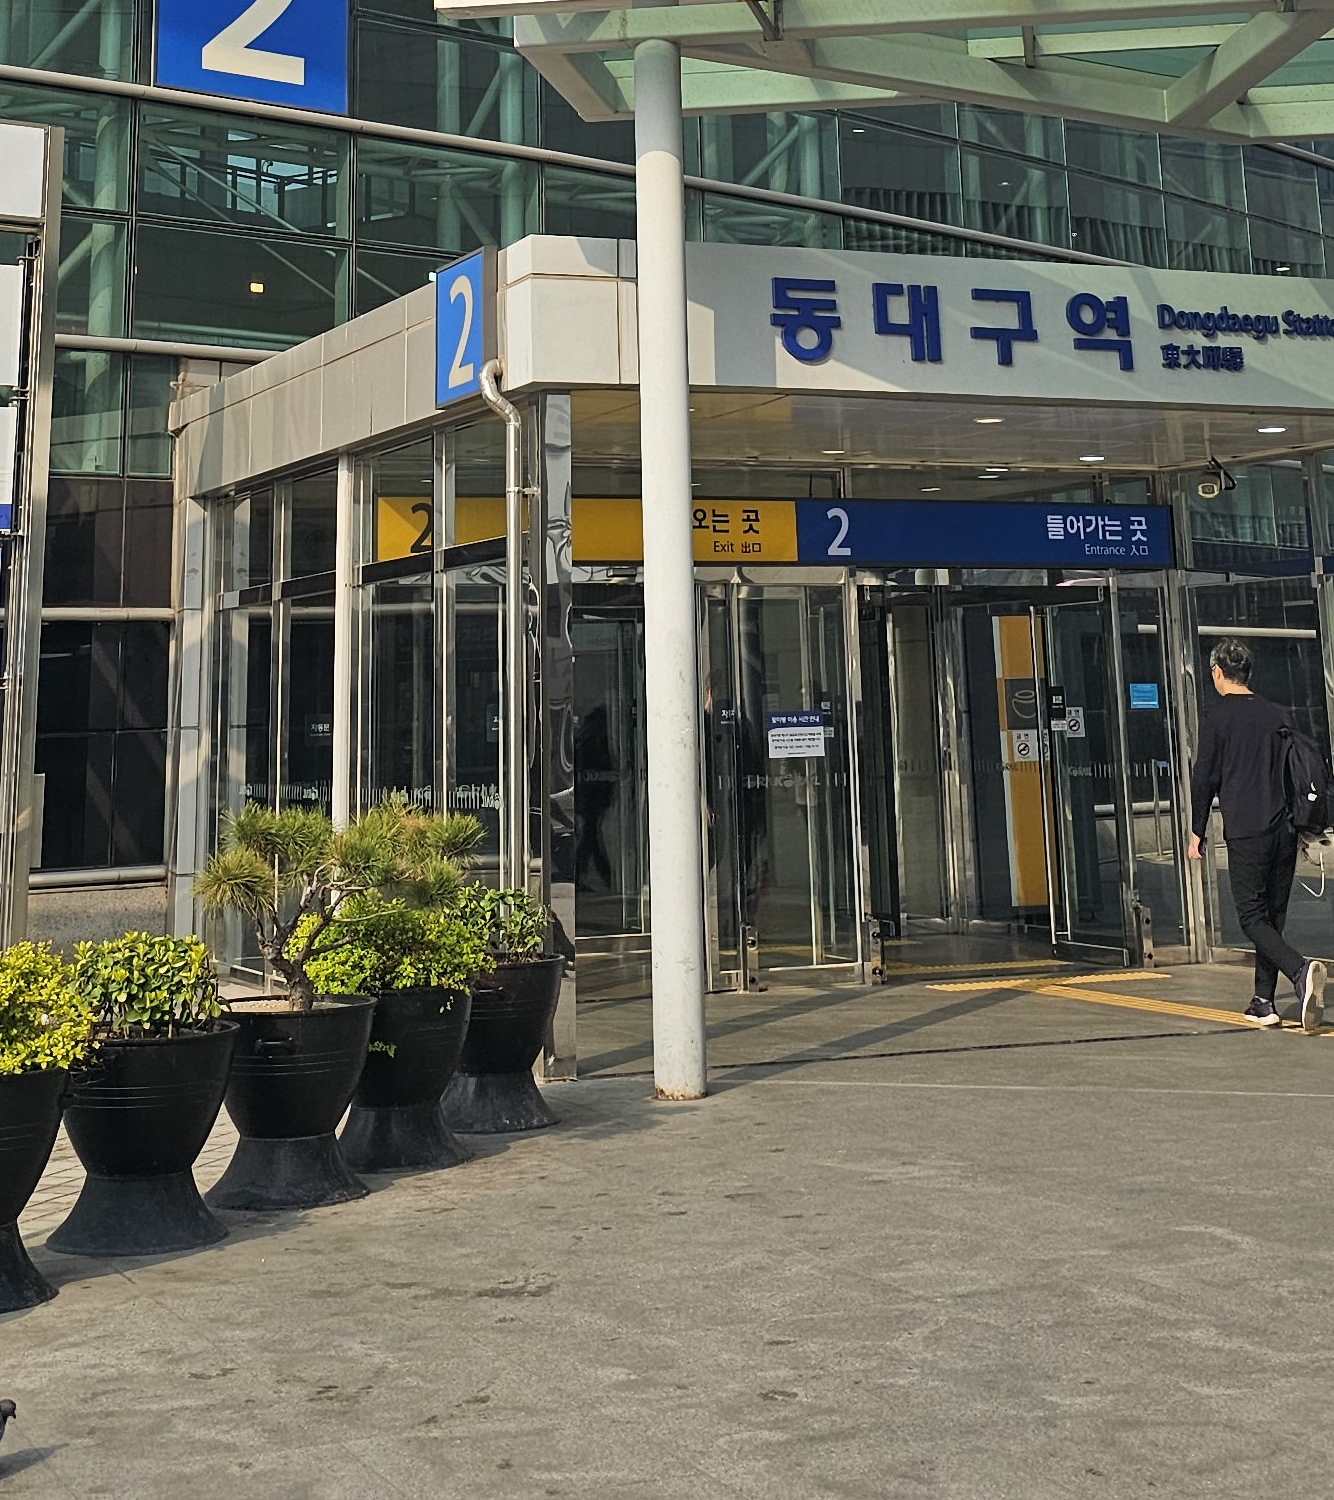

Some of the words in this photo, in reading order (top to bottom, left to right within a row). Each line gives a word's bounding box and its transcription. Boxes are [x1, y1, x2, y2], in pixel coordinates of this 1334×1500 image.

[447, 274, 475, 389] 2
[770, 275, 1134, 372] 동대구역
[1156, 304, 1280, 340] Dongdaegu
[409, 502, 434, 555] 2
[692, 508, 730, 533] 오는
[741, 509, 761, 535] 곳
[826, 507, 852, 556] 2
[1046, 514, 1123, 540] 들어가는
[1129, 516, 1148, 542] 곳
[713, 541, 735, 553] Exit
[741, 541, 762, 554] 出口
[1085, 543, 1126, 555] Entrance
[1130, 544, 1149, 556] 入口
[310, 723, 330, 732] 자동문
